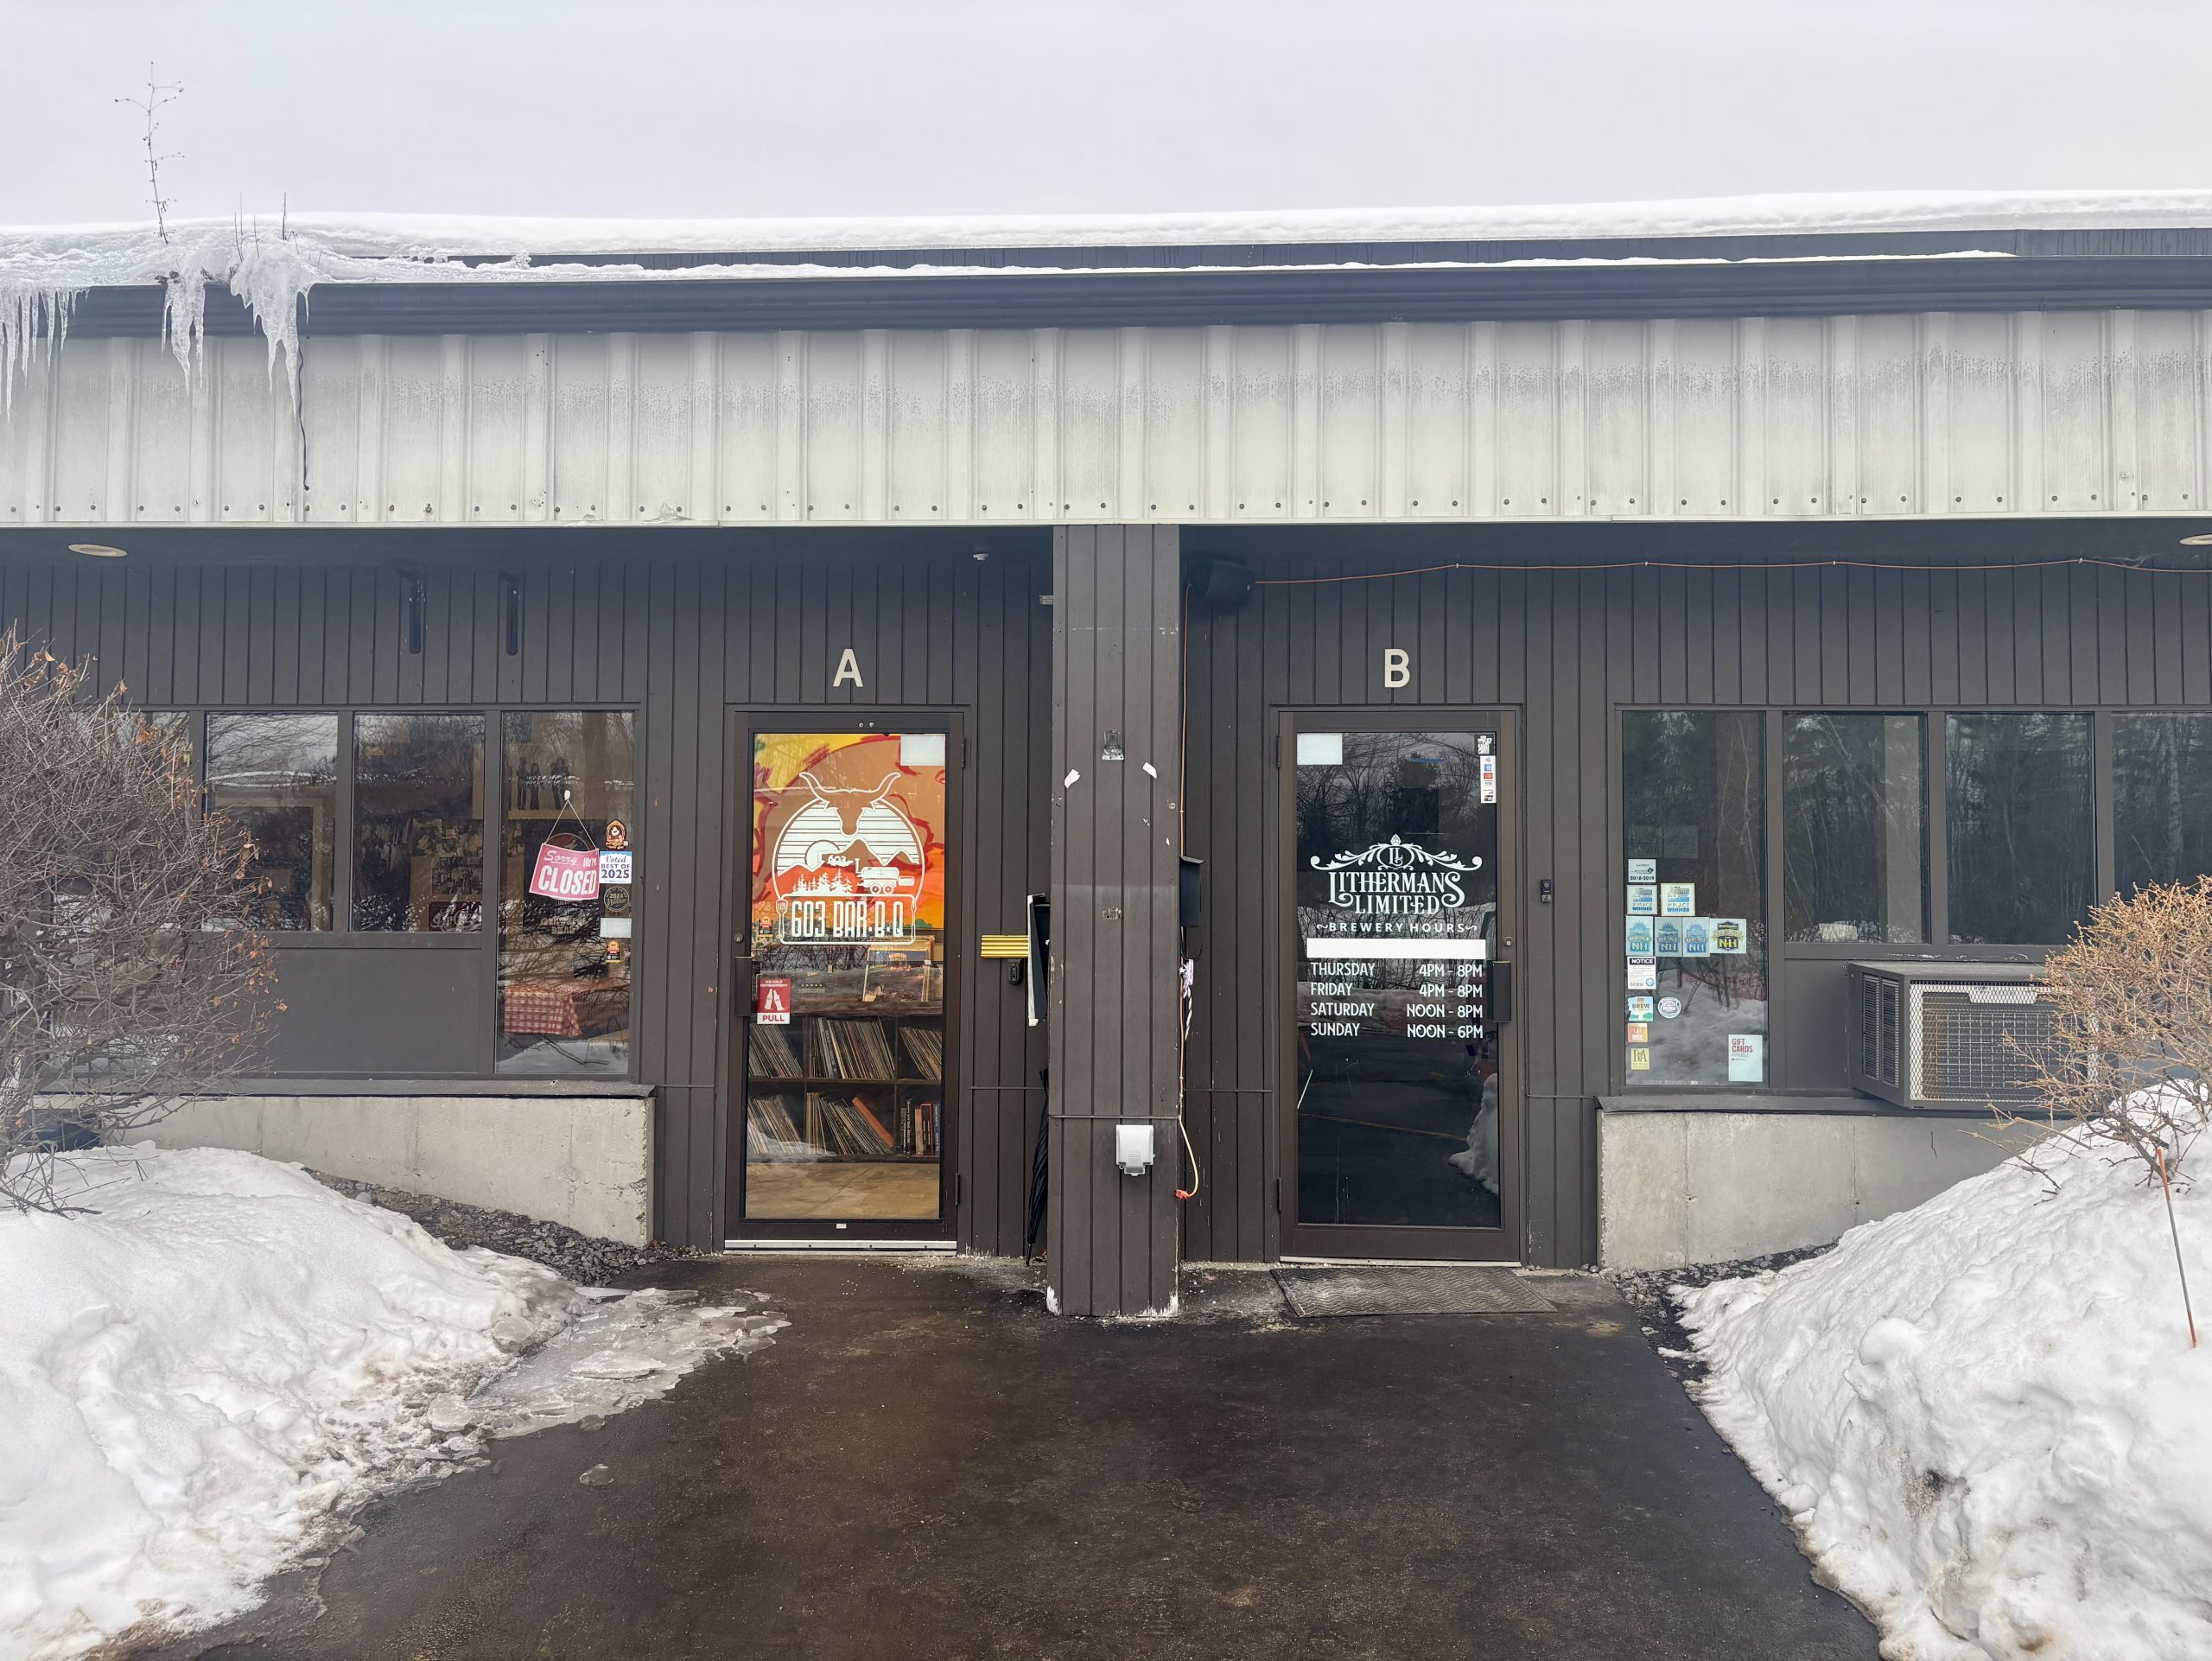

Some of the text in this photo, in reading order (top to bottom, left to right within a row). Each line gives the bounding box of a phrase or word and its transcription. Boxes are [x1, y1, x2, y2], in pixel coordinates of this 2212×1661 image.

[832, 648, 863, 688] A
[1384, 648, 1410, 688] B
[543, 850, 580, 867] Sorry
[605, 855, 626, 863] Voted
[537, 864, 597, 895] CLOSED
[601, 869, 630, 879] 2025
[1328, 871, 1465, 908] LITHERMANS
[1355, 894, 1440, 914] LIMITED
[791, 901, 826, 938] 603
[1328, 922, 1467, 933] BREWERY HOURS
[1631, 942, 1648, 951] NH
[1310, 962, 1376, 977] THURSDAY
[1419, 964, 1445, 977] 4PM
[1457, 964, 1483, 977] 8PM
[1310, 983, 1353, 996] FRIDAY
[1419, 983, 1445, 997] 4PM
[1457, 984, 1483, 998] 8PM
[1310, 1002, 1376, 1016] SATURDAY
[1406, 1003, 1446, 1017] NOON
[1457, 1004, 1484, 1018] 8PM
[1310, 1022, 1361, 1037] SUNDAY
[1407, 1023, 1446, 1038] NOON
[1457, 1025, 1484, 1039] 6PM
